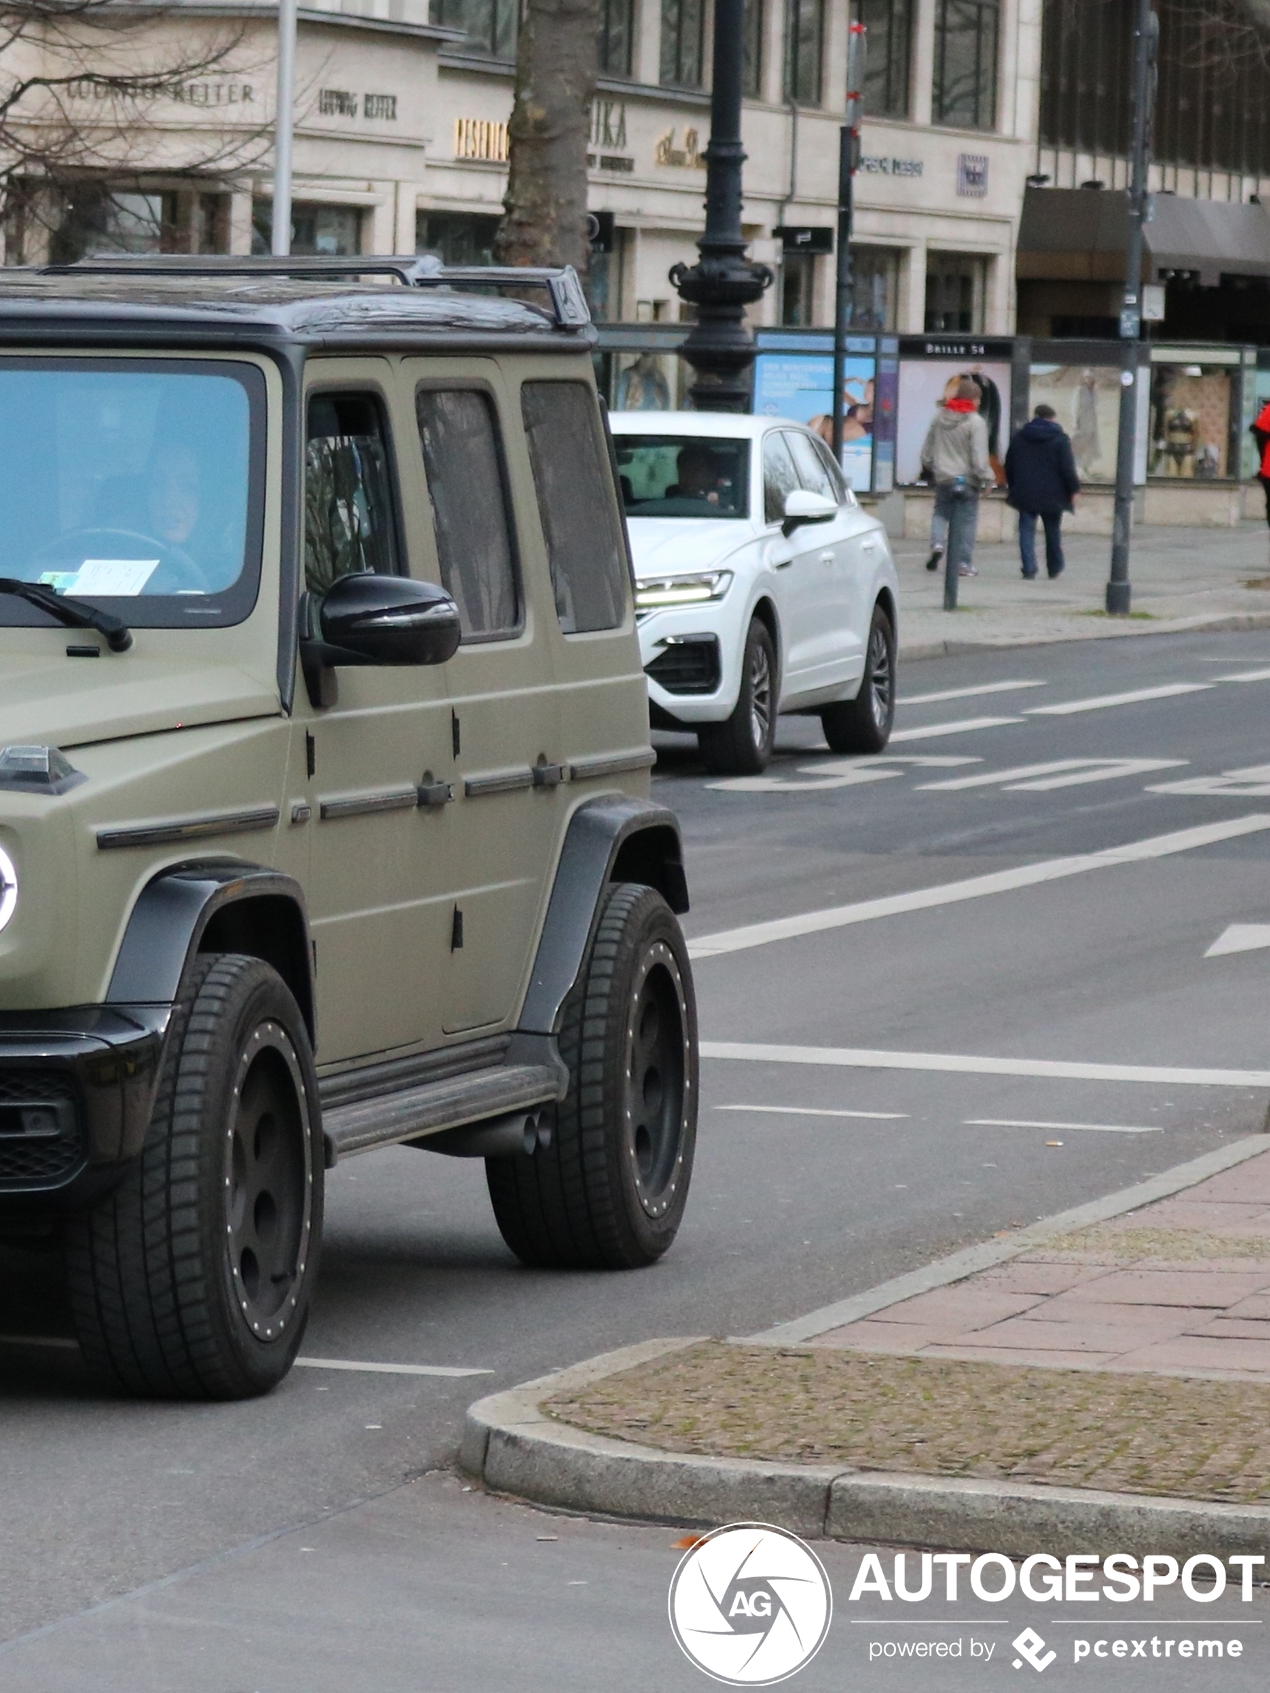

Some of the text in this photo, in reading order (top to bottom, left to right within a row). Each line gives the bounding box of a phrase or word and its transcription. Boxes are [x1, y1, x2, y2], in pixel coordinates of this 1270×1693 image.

[173, 84, 254, 103] REITER
[925, 343, 986, 355] BRILLE 54
